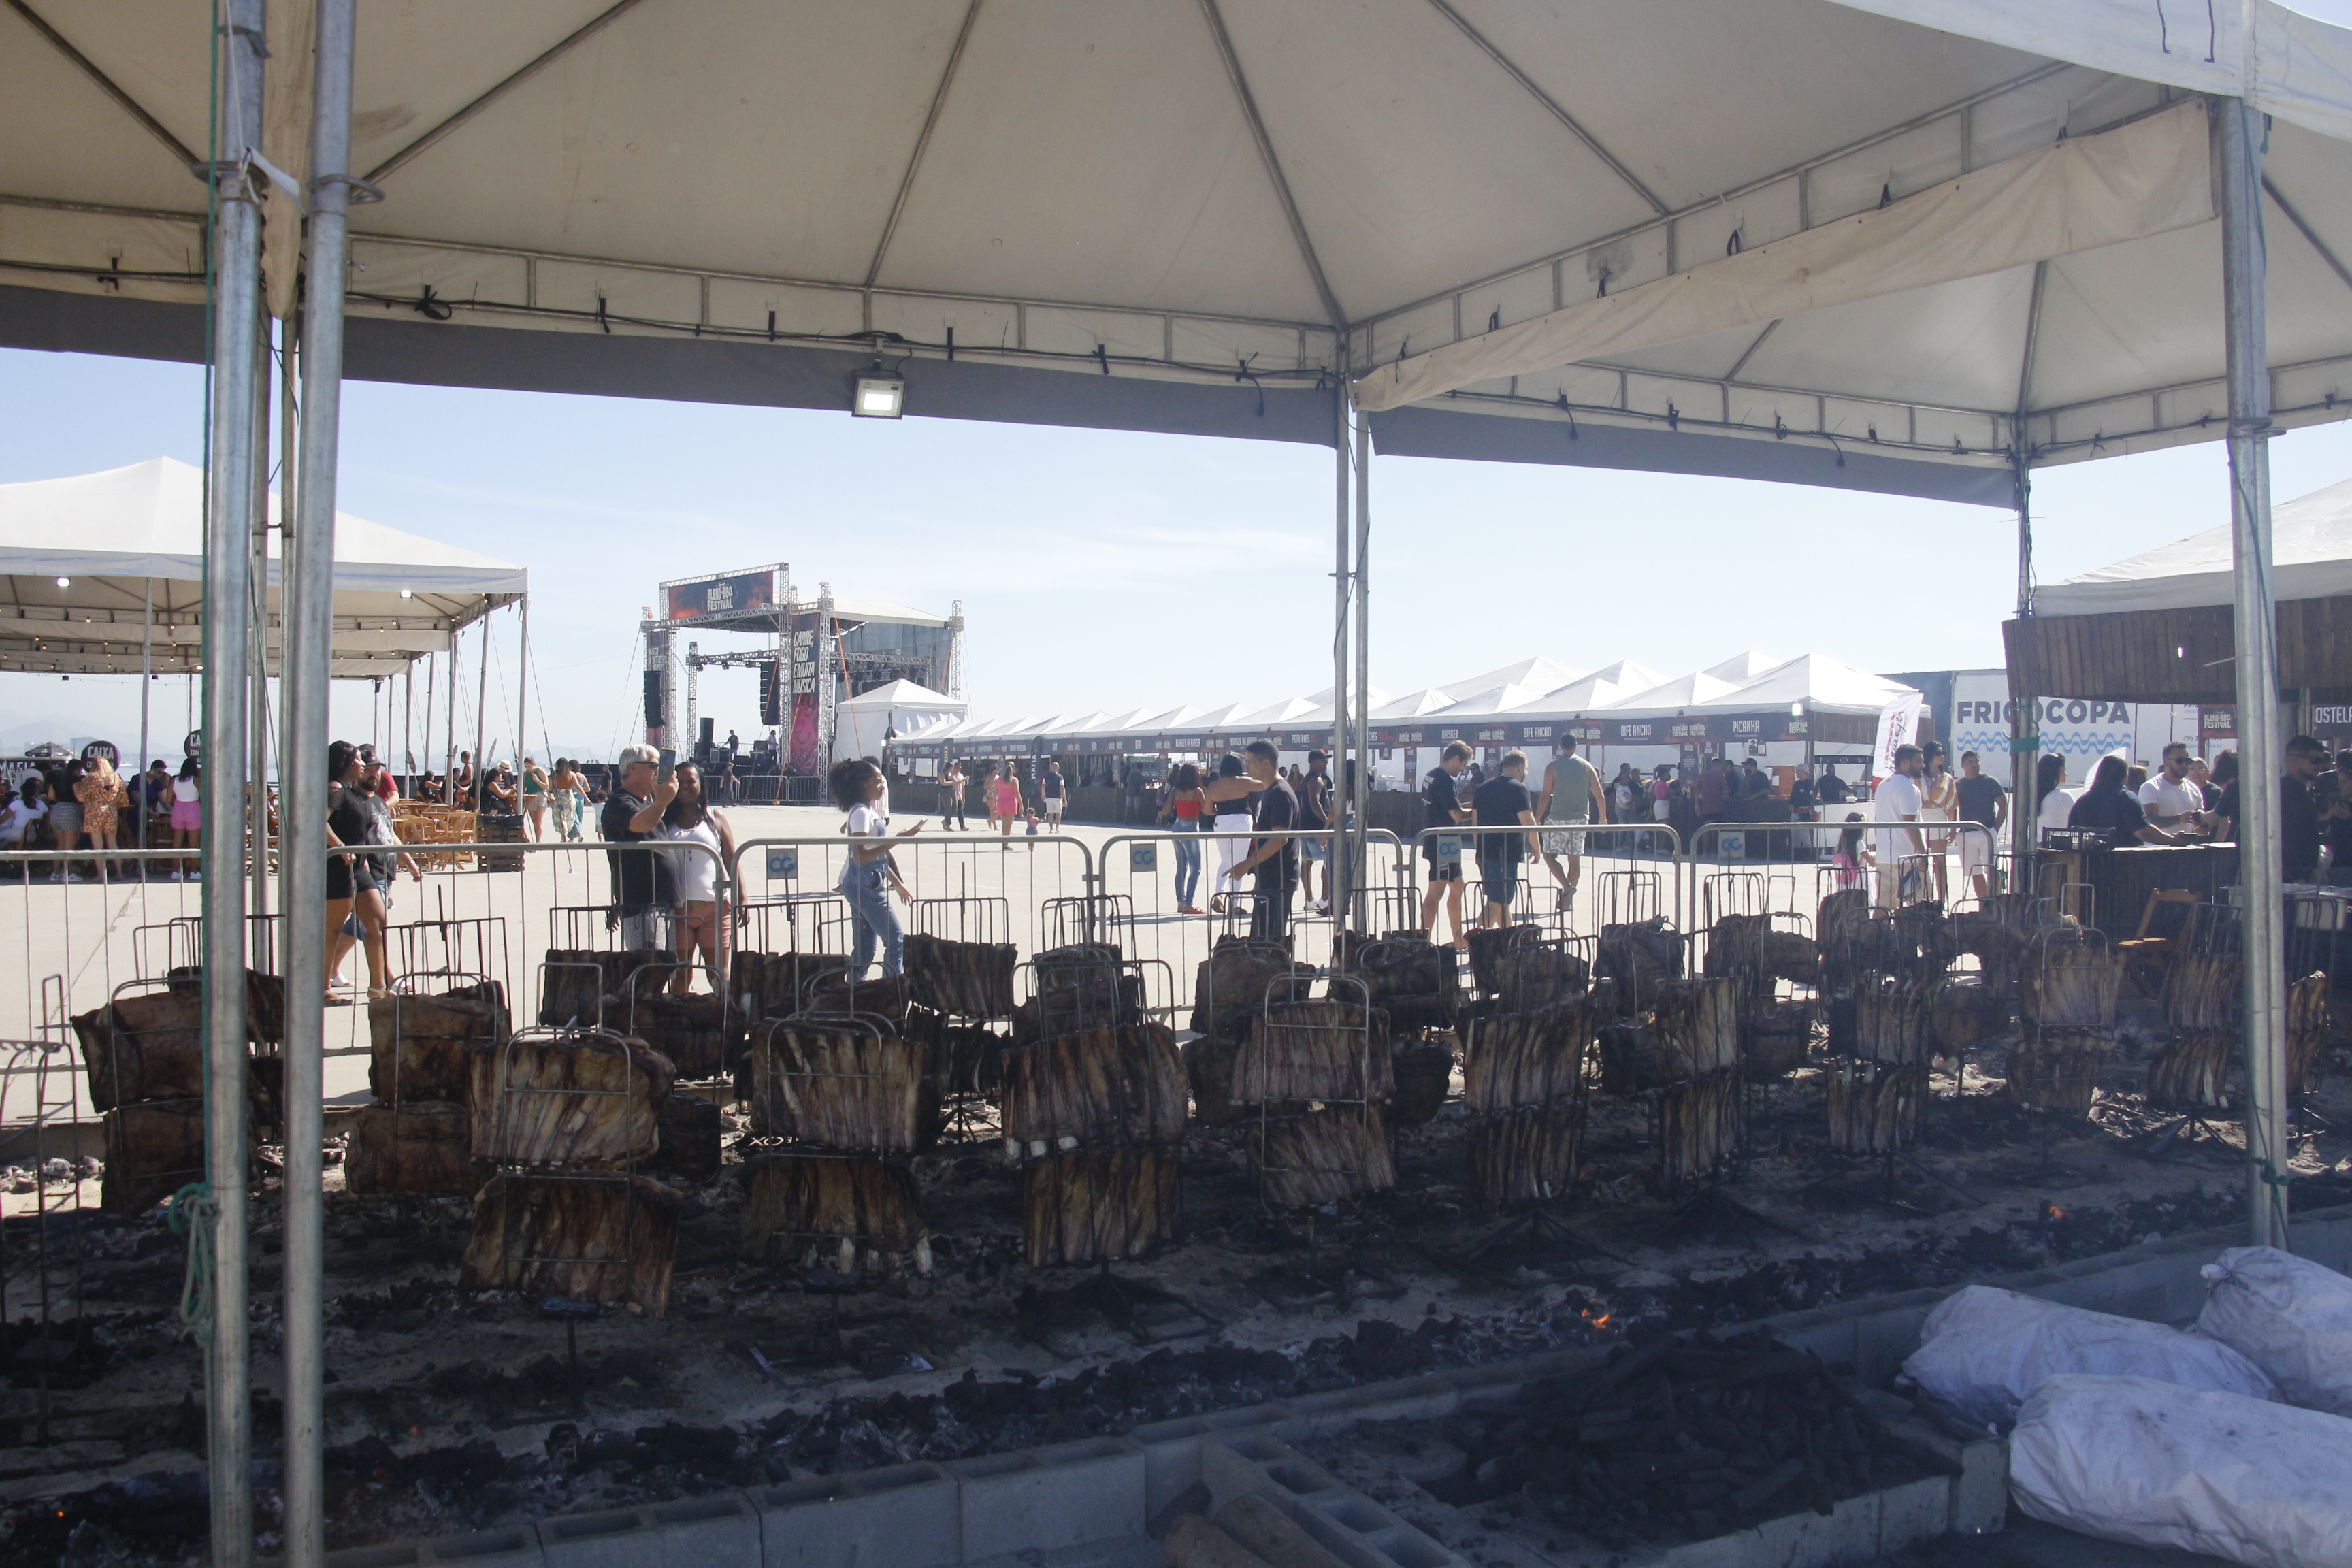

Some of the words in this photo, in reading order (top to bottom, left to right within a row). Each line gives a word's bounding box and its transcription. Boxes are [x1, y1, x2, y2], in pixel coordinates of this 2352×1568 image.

[707, 598, 734, 612] FESTIVAL
[794, 630, 814, 647] CARNE,
[794, 647, 809, 663] FOGO
[2315, 706, 2352, 723] OSTEL
[1523, 727, 1534, 738] BIFE
[1535, 726, 1552, 737] ANCHO
[1620, 725, 1631, 736] BIFE
[1633, 724, 1652, 736] ANCHO
[1733, 720, 1760, 733] PICANHA
[1441, 729, 1459, 740] BRISKET
[88, 745, 114, 760] CAIXA
